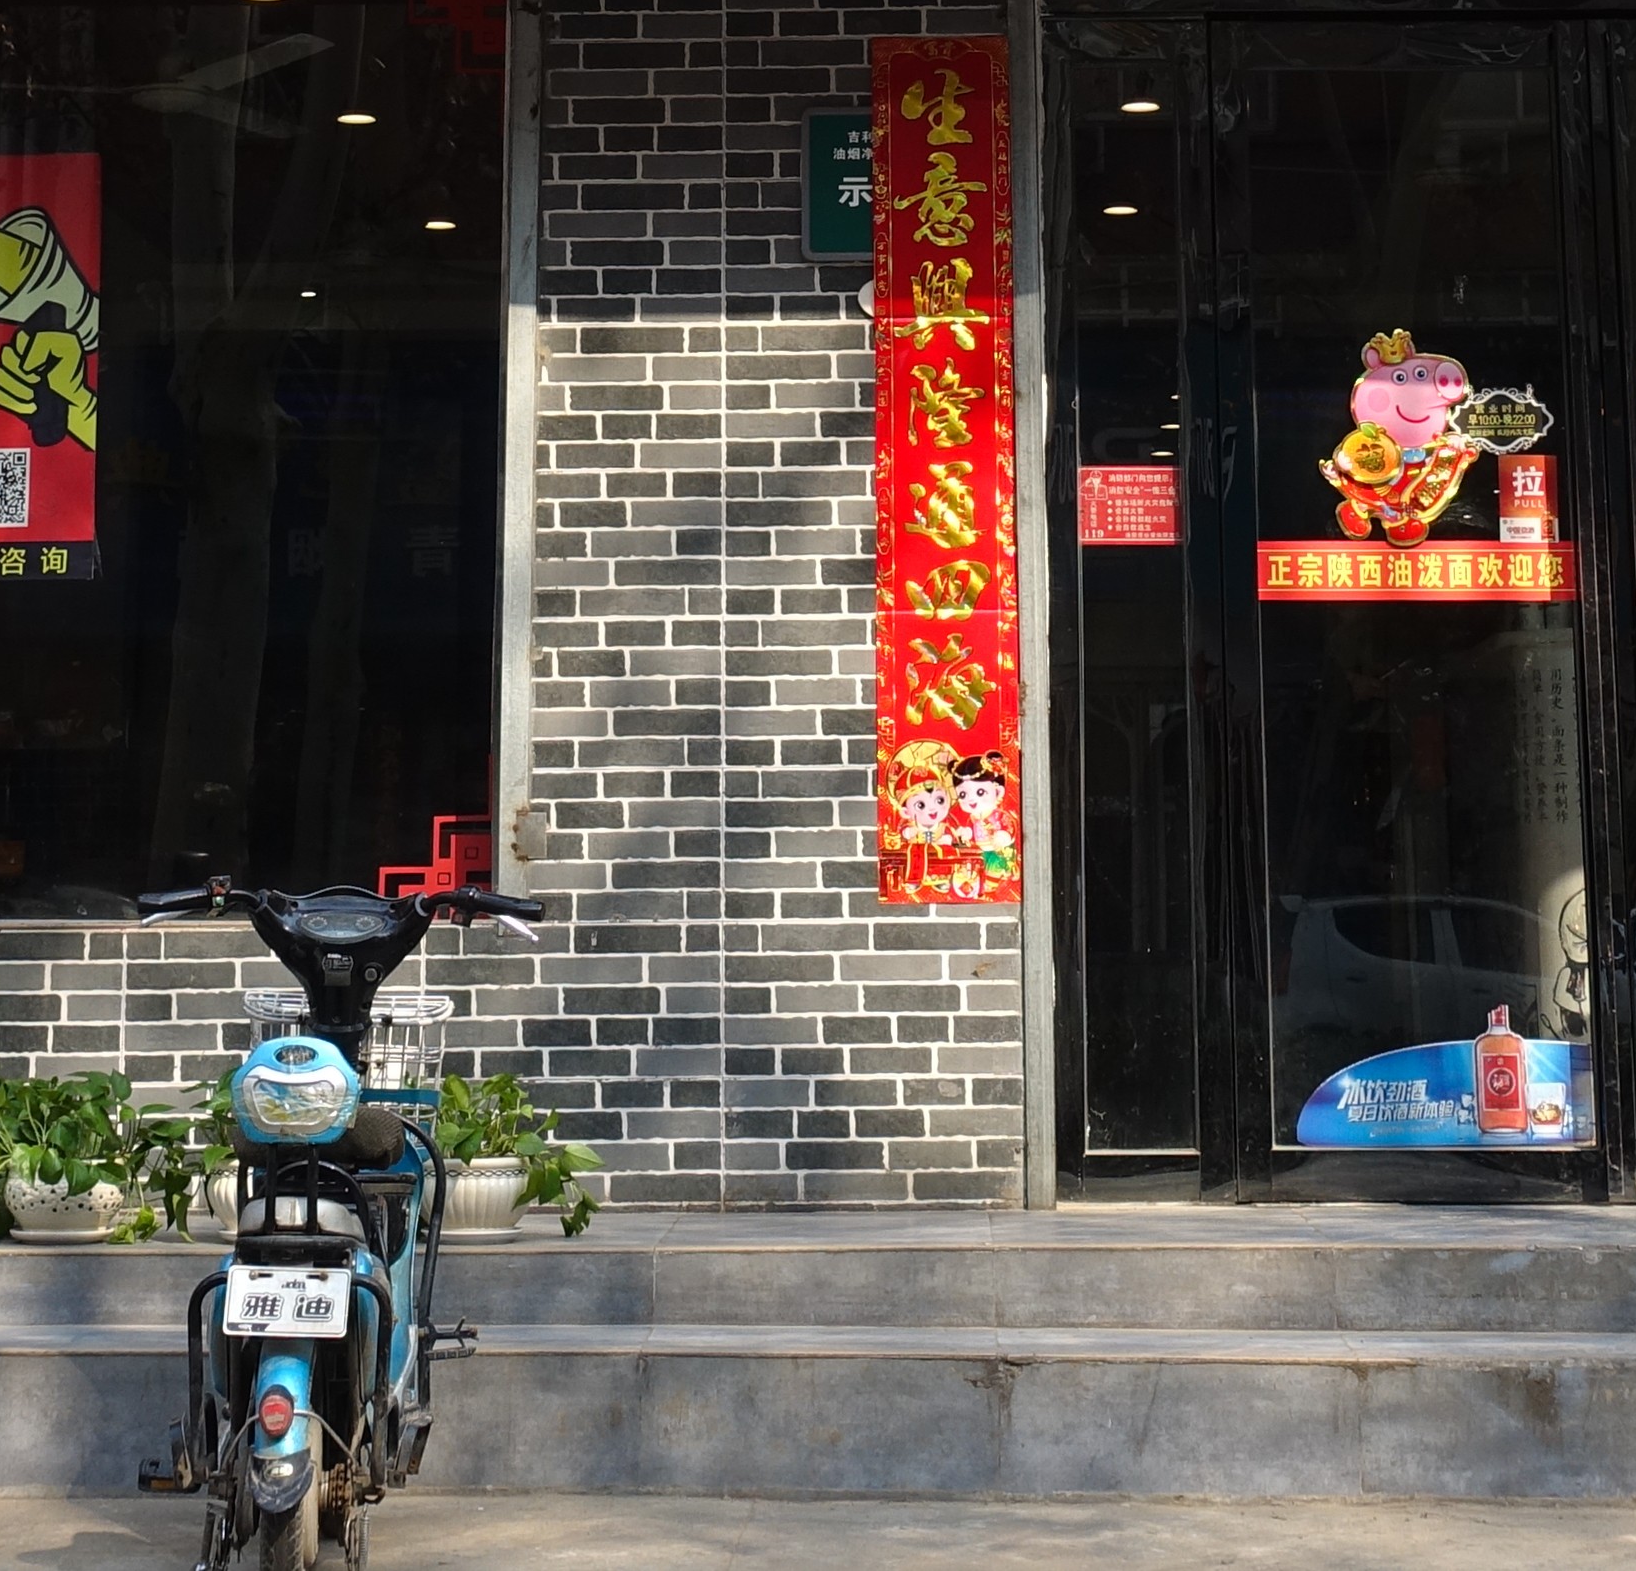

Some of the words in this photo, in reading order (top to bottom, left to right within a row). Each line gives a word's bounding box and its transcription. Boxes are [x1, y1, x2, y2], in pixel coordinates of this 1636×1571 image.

[838, 176, 874, 208] 示
[1512, 466, 1545, 498] 拉
[1514, 499, 1544, 509] PULL
[1084, 529, 1104, 539] 119
[1267, 552, 1565, 587] 正宗陕西油泼面欢迎您
[1337, 1079, 1428, 1109] 冰饮劲酒
[241, 1292, 334, 1322] 雅迪
